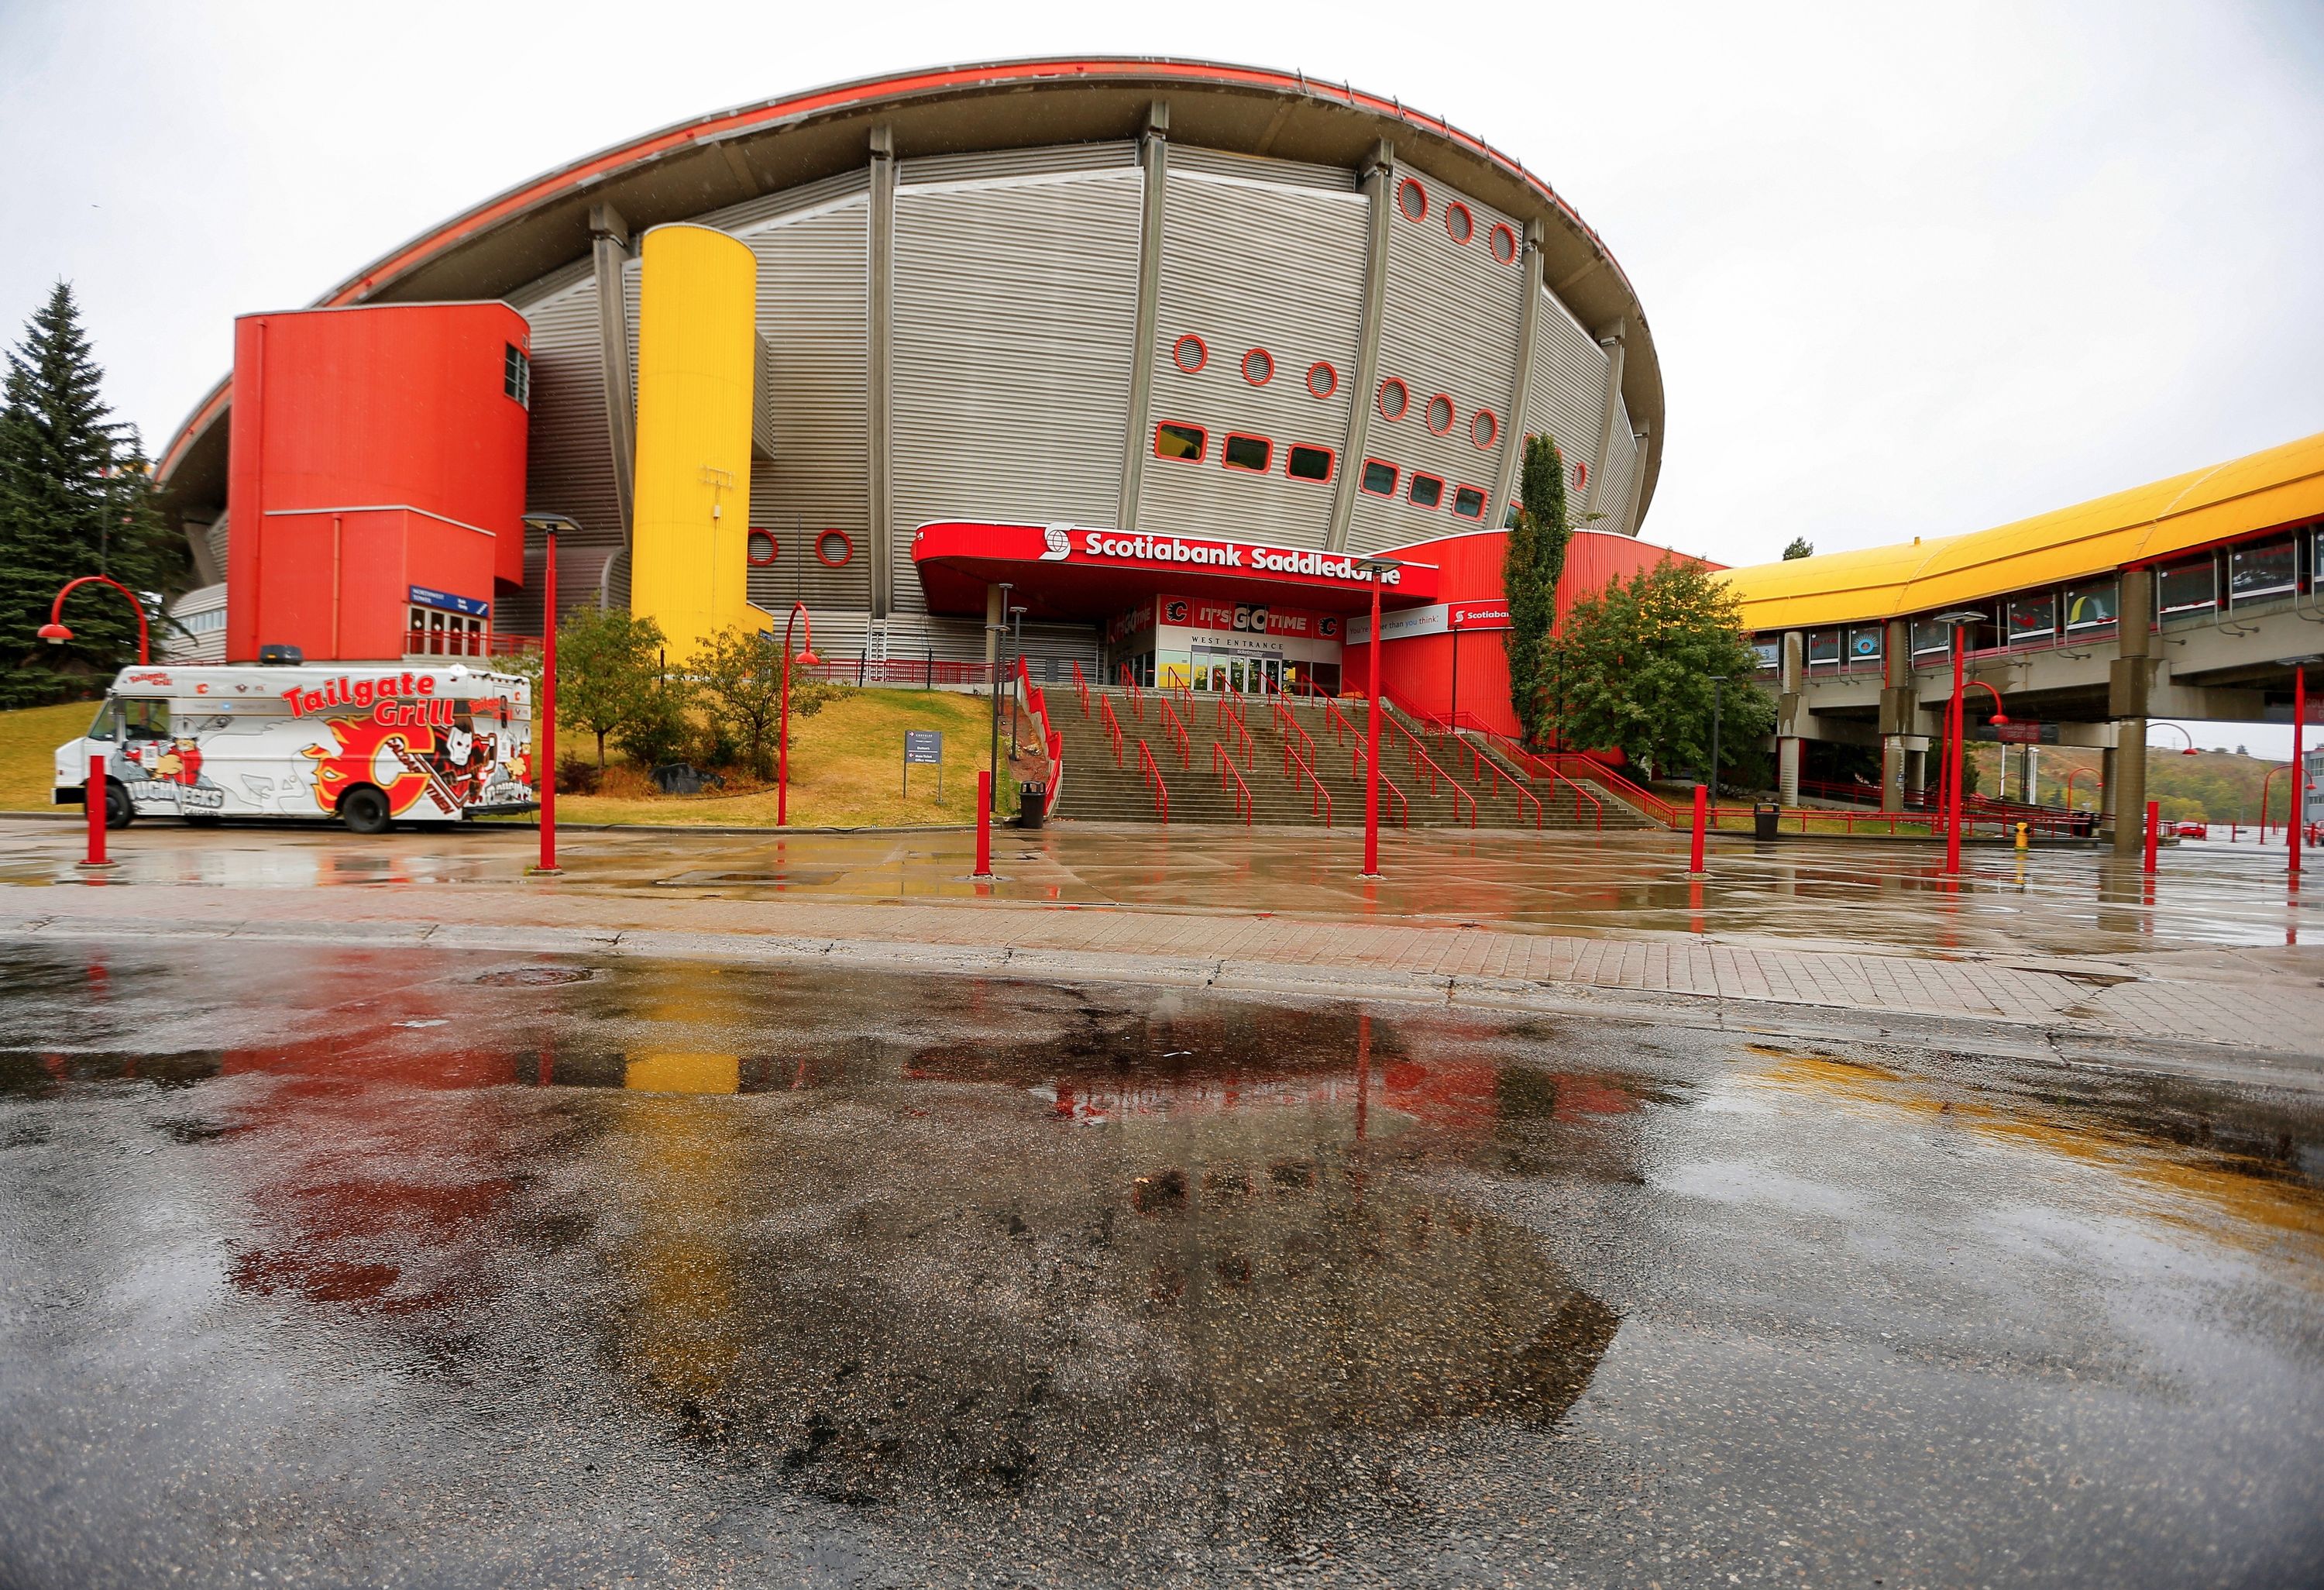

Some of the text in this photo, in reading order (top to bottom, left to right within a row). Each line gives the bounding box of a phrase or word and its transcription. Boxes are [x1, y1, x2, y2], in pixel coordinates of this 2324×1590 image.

[1086, 533, 1243, 567] Scotiabank
[1199, 607, 1308, 632] IT'S GO TIME
[1389, 621, 1404, 629] than
[1405, 620, 1418, 628] you
[1467, 610, 1510, 619] Scotiaba
[1349, 626, 1369, 635] You're
[1191, 635, 1284, 650] WEST ENTRANCE
[280, 672, 436, 719] Tailgate
[373, 698, 456, 727] Grill
